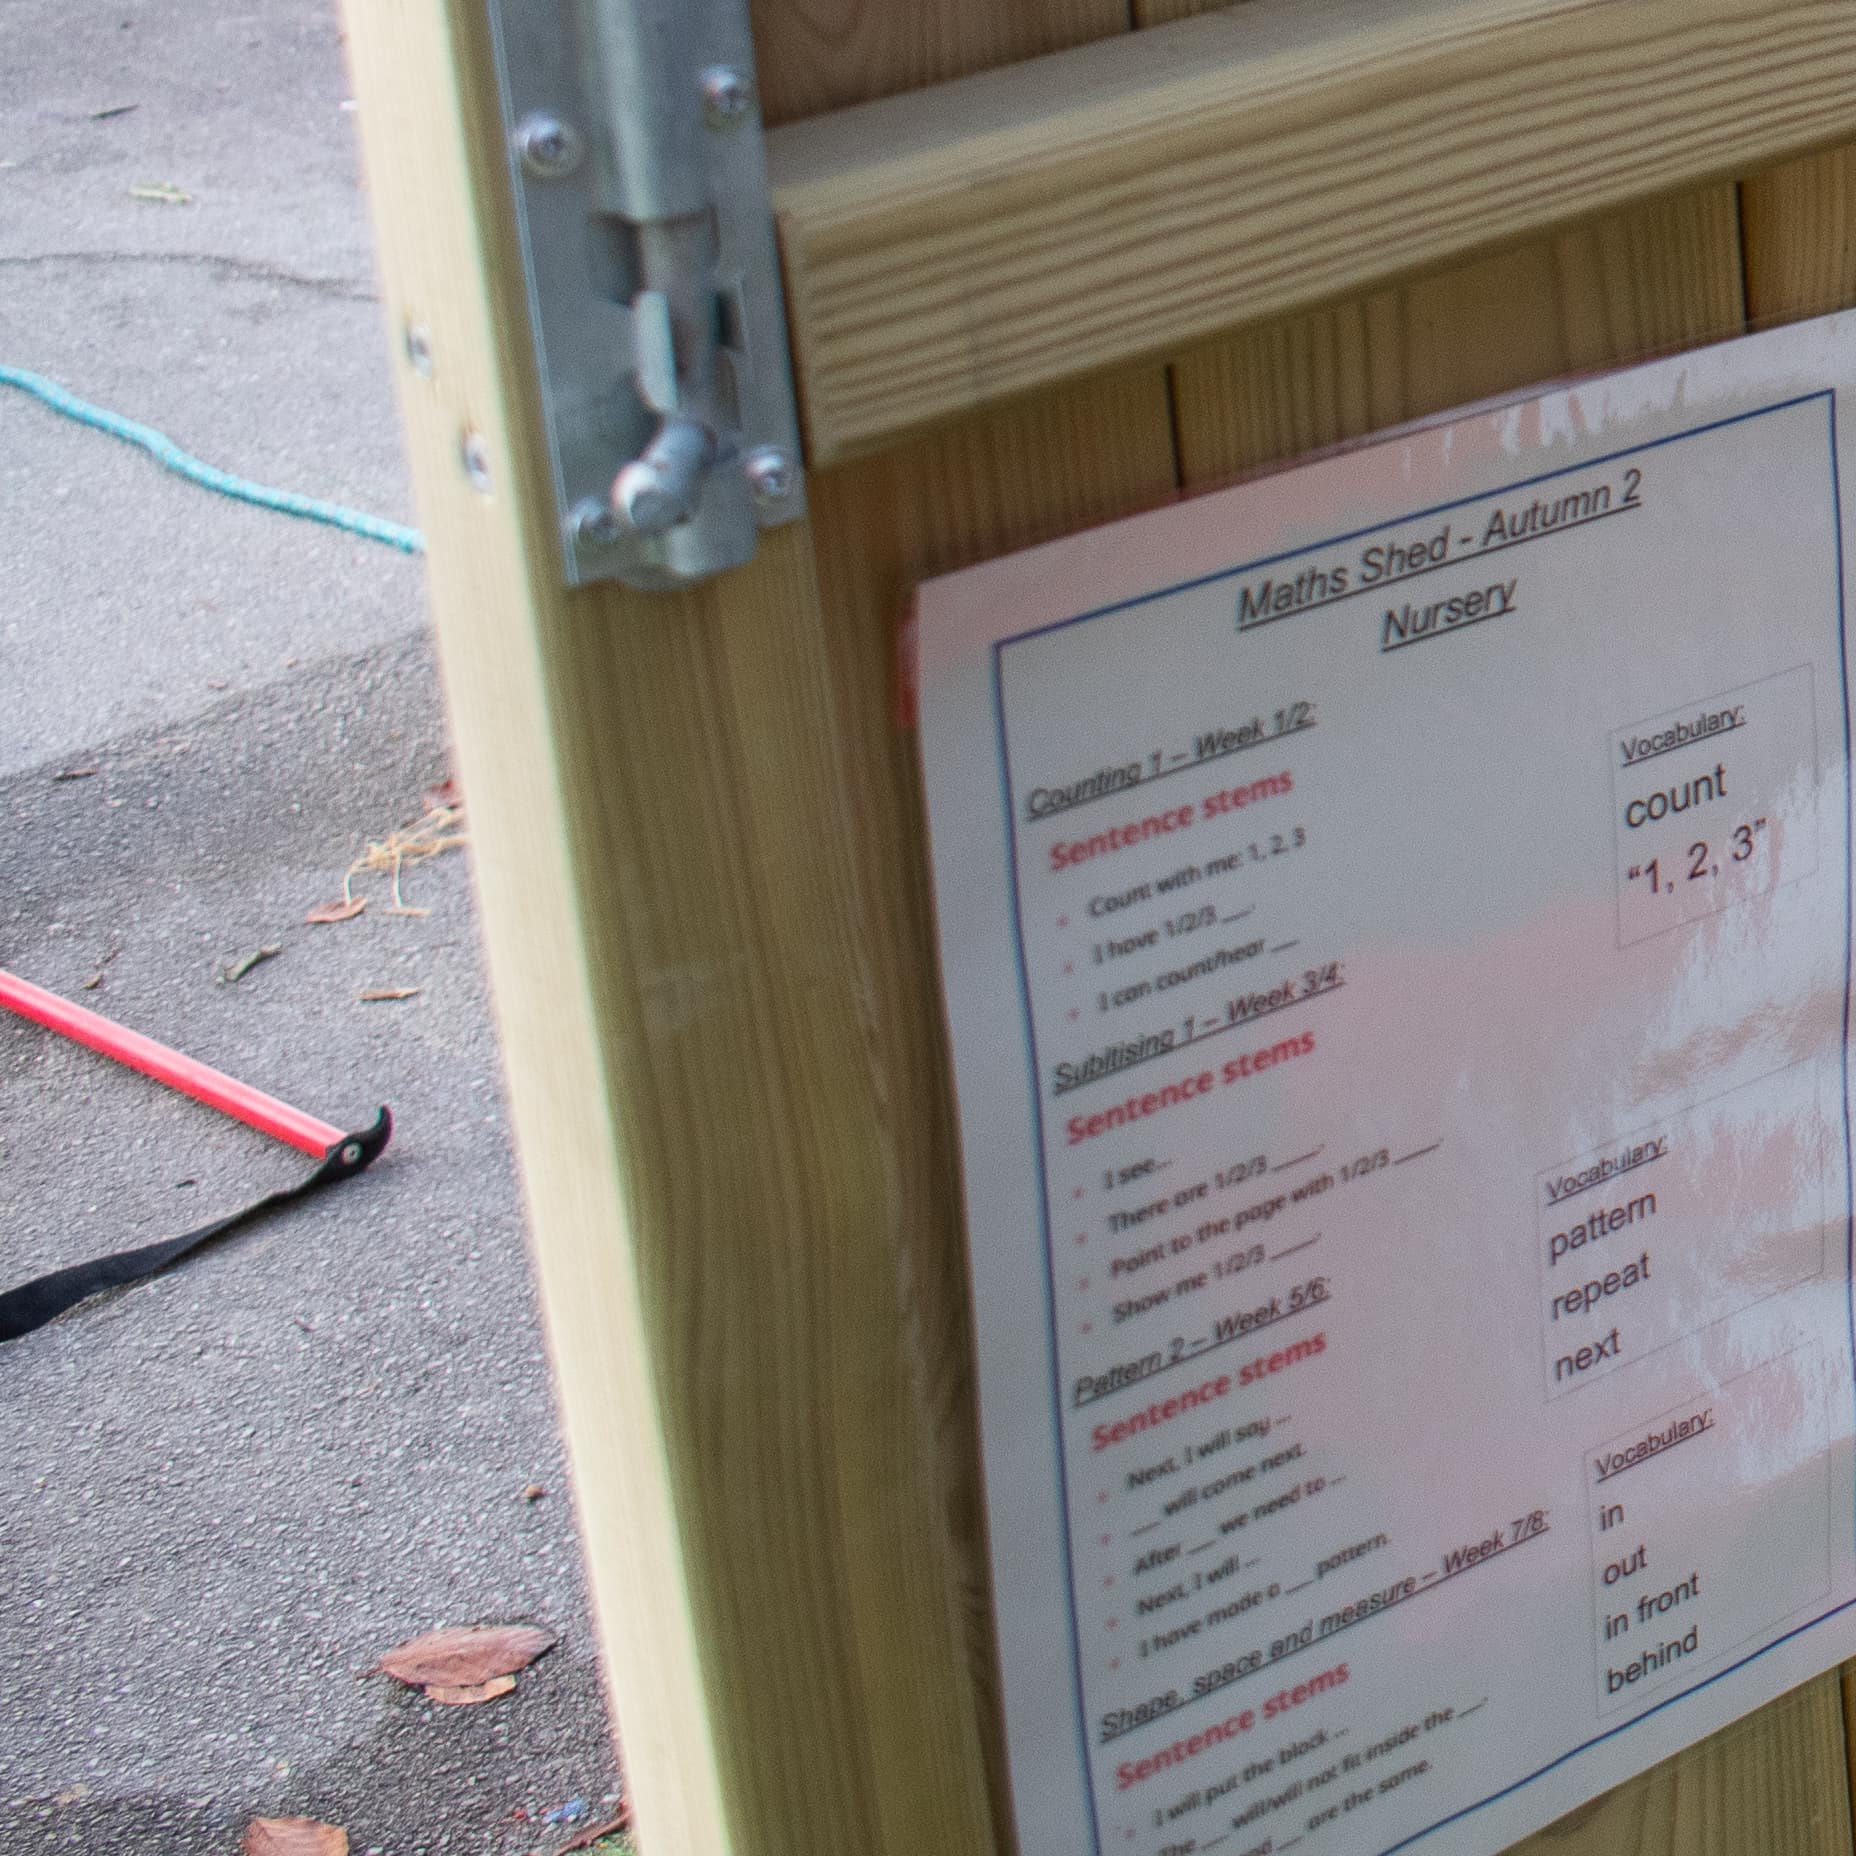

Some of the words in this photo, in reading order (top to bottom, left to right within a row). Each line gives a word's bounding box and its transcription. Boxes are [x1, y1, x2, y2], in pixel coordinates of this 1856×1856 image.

[1236, 563, 1349, 628] Maths
[1359, 524, 1450, 584] Shed
[1483, 483, 1613, 544] Autumn
[1621, 466, 1644, 504] 2
[1382, 577, 1519, 646] Nursery
[1027, 763, 1141, 818] Counting
[1148, 750, 1162, 772] 1
[1193, 716, 1264, 758] Week
[1619, 704, 1747, 765] Vocabulary:
[1049, 804, 1195, 871] Sentence
[1202, 769, 1294, 821] stems
[1625, 761, 1728, 830] count
[1087, 882, 1152, 917] Count
[1155, 863, 1202, 894] with
[1293, 826, 1308, 848] 3
[1686, 840, 1720, 882] 2,
[1093, 943, 1104, 965] I
[1107, 929, 1159, 960] have
[1165, 904, 1219, 938] 1/2/3
[1098, 990, 1109, 1012] I
[1112, 981, 1152, 1009] can
[1054, 1028, 1175, 1094] Subitising
[1183, 1015, 1195, 1040] 1
[1227, 979, 1297, 1022] Week
[1066, 1070, 1215, 1144] Sentence
[1221, 1030, 1316, 1086] stems
[1106, 1198, 1170, 1234] There
[1173, 1182, 1208, 1208] are
[1214, 1154, 1268, 1190] 1/2/3
[1545, 1134, 1670, 1206] Vocabulary:
[1110, 1244, 1166, 1279] Point
[1170, 1234, 1193, 1255] to
[1195, 1217, 1232, 1244] the
[1234, 1194, 1287, 1231] page
[1290, 1173, 1336, 1205] with
[1340, 1147, 1391, 1183] 1/2/3
[1547, 1191, 1659, 1270] pattern
[1111, 1288, 1171, 1325] Show
[1175, 1271, 1208, 1297] me
[1214, 1243, 1266, 1280] 1/2/3
[1550, 1249, 1653, 1323] repeat
[1074, 1351, 1162, 1406] Pattern
[1168, 1336, 1186, 1363] 2
[1214, 1297, 1281, 1340] Week
[1554, 1325, 1623, 1385] next
[1092, 1374, 1231, 1453] Sentence
[1238, 1331, 1328, 1386] stems
[1197, 1429, 1231, 1459] will
[1234, 1416, 1271, 1444] say
[1593, 1406, 1716, 1481] Vocabulary:
[1134, 1543, 1182, 1576] After
[1219, 1512, 1249, 1535] we
[1252, 1485, 1301, 1521] need
[1304, 1476, 1326, 1497] to
[1164, 1486, 1198, 1517] will
[1201, 1465, 1257, 1500] come
[1598, 1502, 1626, 1534] in
[1206, 1554, 1240, 1584] will
[1603, 1542, 1648, 1586] out
[1100, 1686, 1186, 1741] Shape,
[1192, 1648, 1264, 1699] space
[1268, 1618, 1314, 1659] and
[1319, 1575, 1416, 1636] measure
[1440, 1529, 1505, 1575] Week
[1509, 1508, 1550, 1541] 7/8:
[1152, 1618, 1202, 1651] have
[1206, 1590, 1264, 1626] made
[1266, 1582, 1281, 1600] a
[1605, 1612, 1629, 1639] in
[1637, 1571, 1700, 1623] front
[1607, 1625, 1699, 1695] behind
[1116, 1708, 1256, 1792] Sentence
[1261, 1662, 1351, 1721] stems
[1167, 1790, 1202, 1821] will
[1205, 1773, 1238, 1805] put
[1242, 1758, 1274, 1785] the
[1277, 1728, 1328, 1765] block
[1232, 1779, 1303, 1830] will/will
[1306, 1765, 1339, 1792] not
[1342, 1748, 1362, 1773] fit
[1365, 1723, 1420, 1761] inside
[1422, 1706, 1455, 1733] the
[1306, 1804, 1339, 1831] are
[1343, 1786, 1374, 1813] the
[1378, 1759, 1432, 1795] same.
